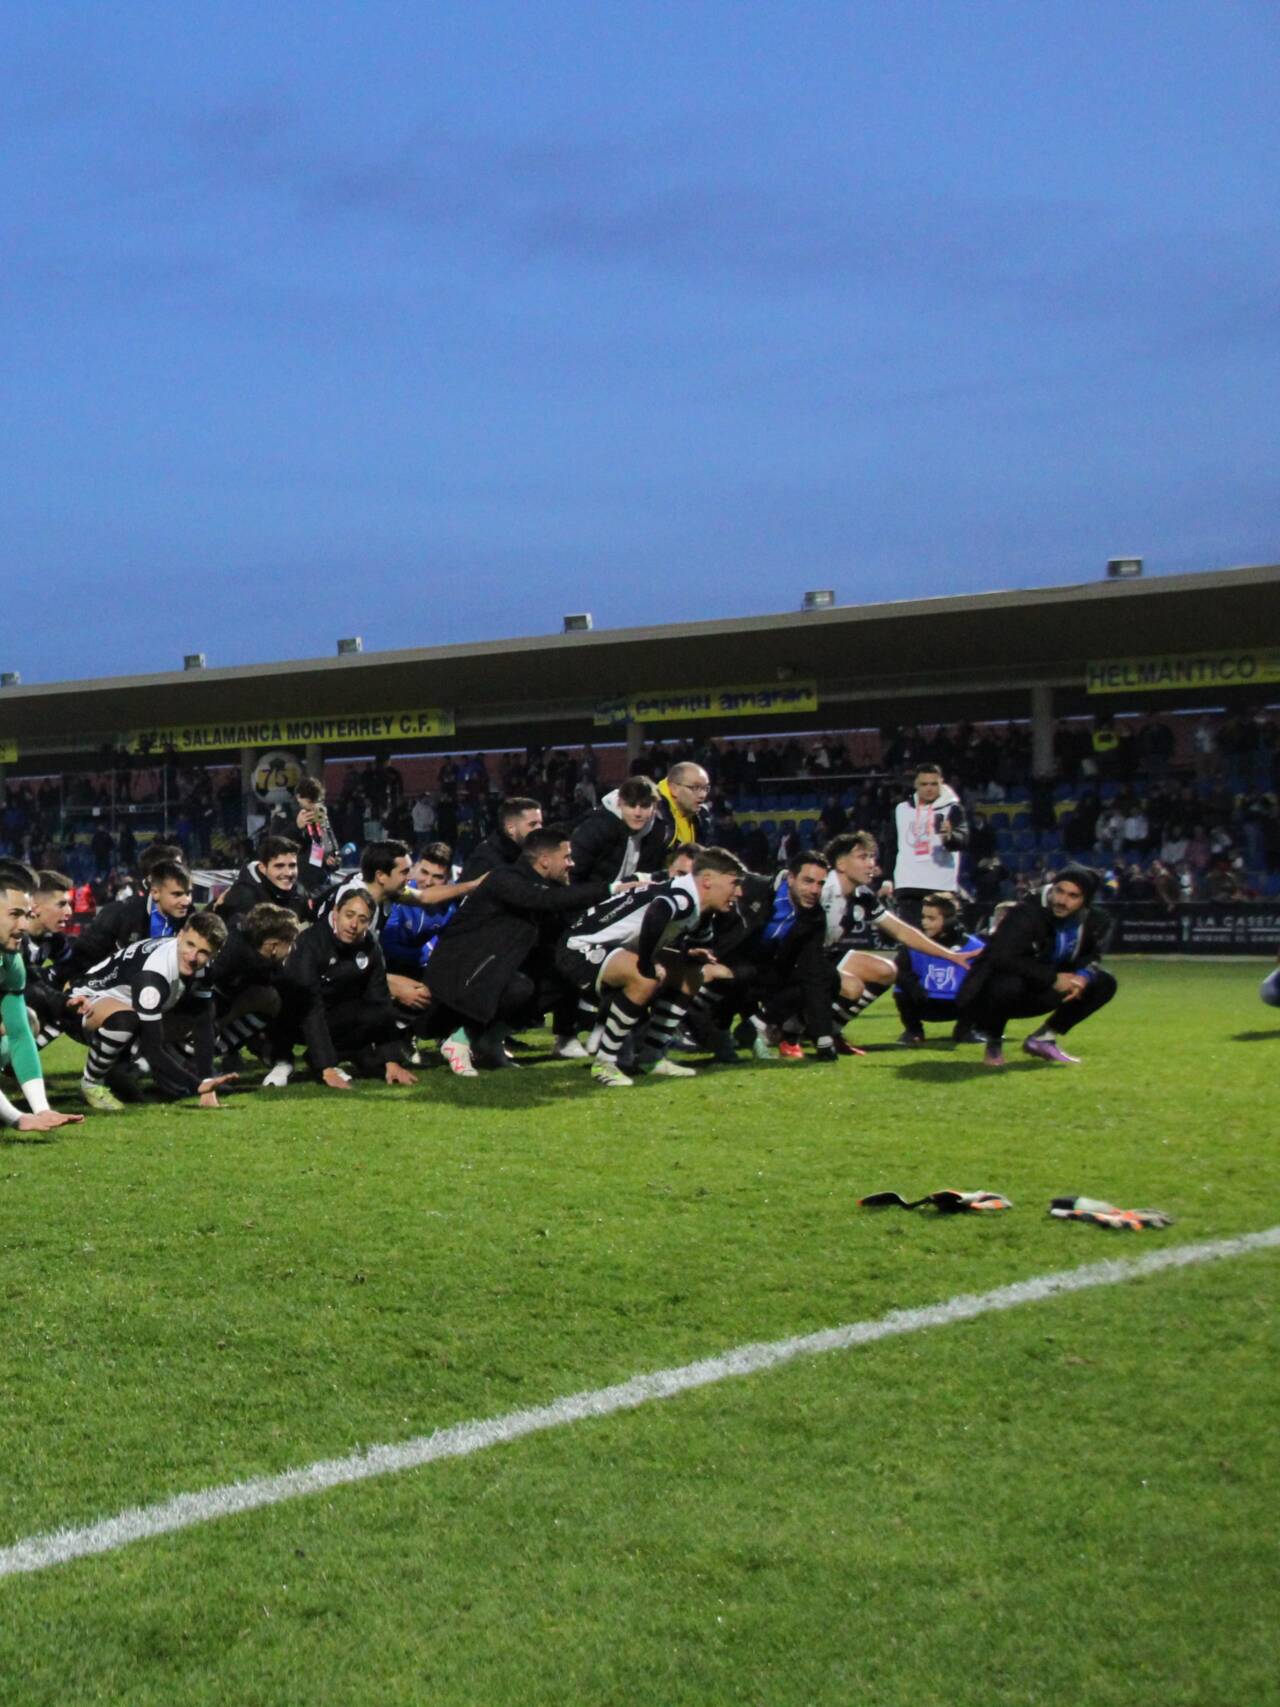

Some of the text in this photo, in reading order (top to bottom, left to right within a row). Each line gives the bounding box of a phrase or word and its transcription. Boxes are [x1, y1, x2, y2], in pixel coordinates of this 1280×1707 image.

[1088, 656, 1256, 688] HELMANTICO
[182, 719, 282, 747] SALAMANCA
[286, 714, 394, 740] MONTERREY
